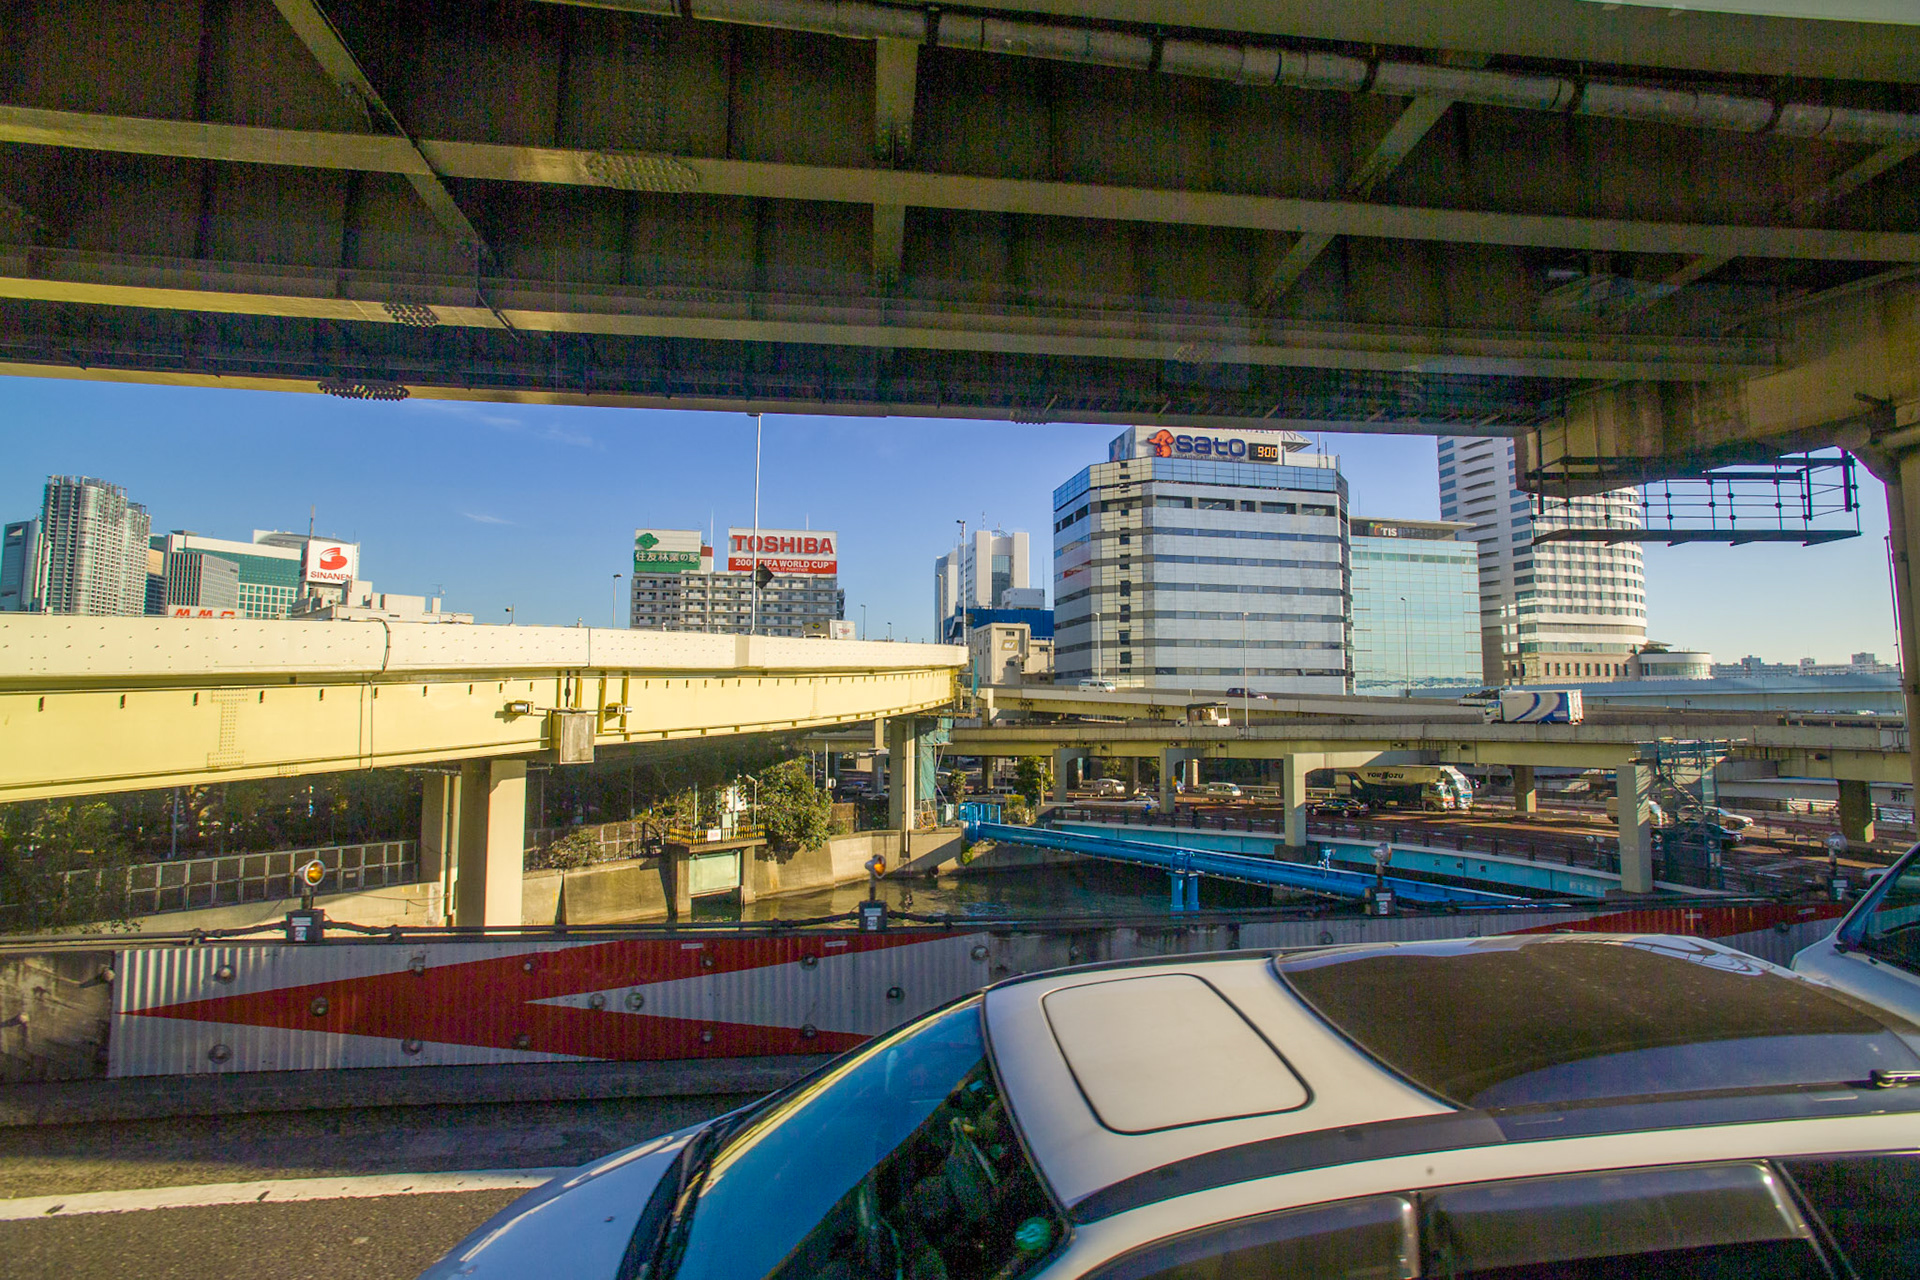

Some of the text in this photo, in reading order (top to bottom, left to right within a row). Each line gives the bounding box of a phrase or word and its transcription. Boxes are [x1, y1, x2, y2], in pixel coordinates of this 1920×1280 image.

[1175, 434, 1246, 457] sato
[1380, 527, 1397, 537] TIS
[732, 535, 834, 554] TOSHIBA
[636, 551, 699, 563] 住友林業の家
[735, 559, 757, 567] 200
[779, 560, 810, 568] WORLD
[310, 570, 353, 581] SINANEN
